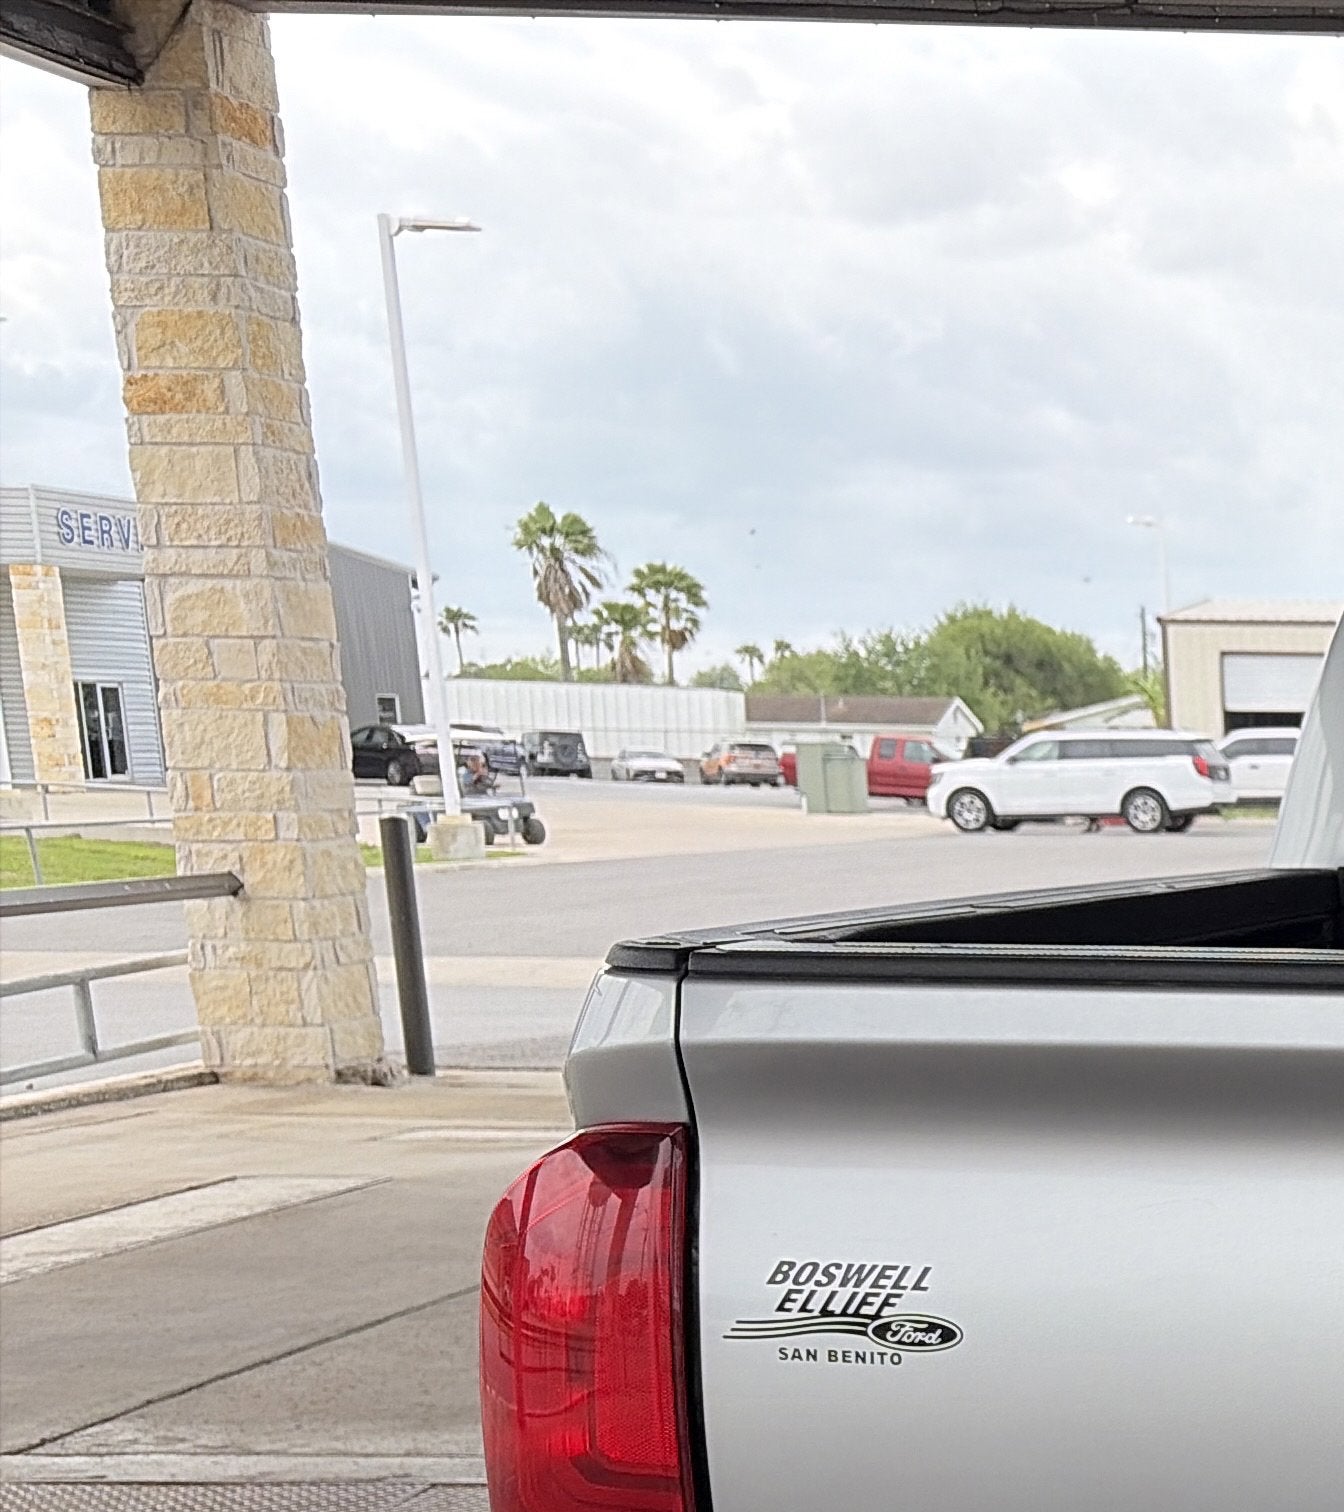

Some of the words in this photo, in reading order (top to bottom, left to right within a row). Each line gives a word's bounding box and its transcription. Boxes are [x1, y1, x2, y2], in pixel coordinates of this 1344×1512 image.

[57, 508, 145, 552] SERV
[766, 1260, 932, 1291] BOSWELL
[775, 1289, 903, 1316] ELLIFF
[886, 1320, 942, 1345] Ford
[778, 1347, 818, 1362] SAN
[827, 1349, 903, 1365] BENITO
